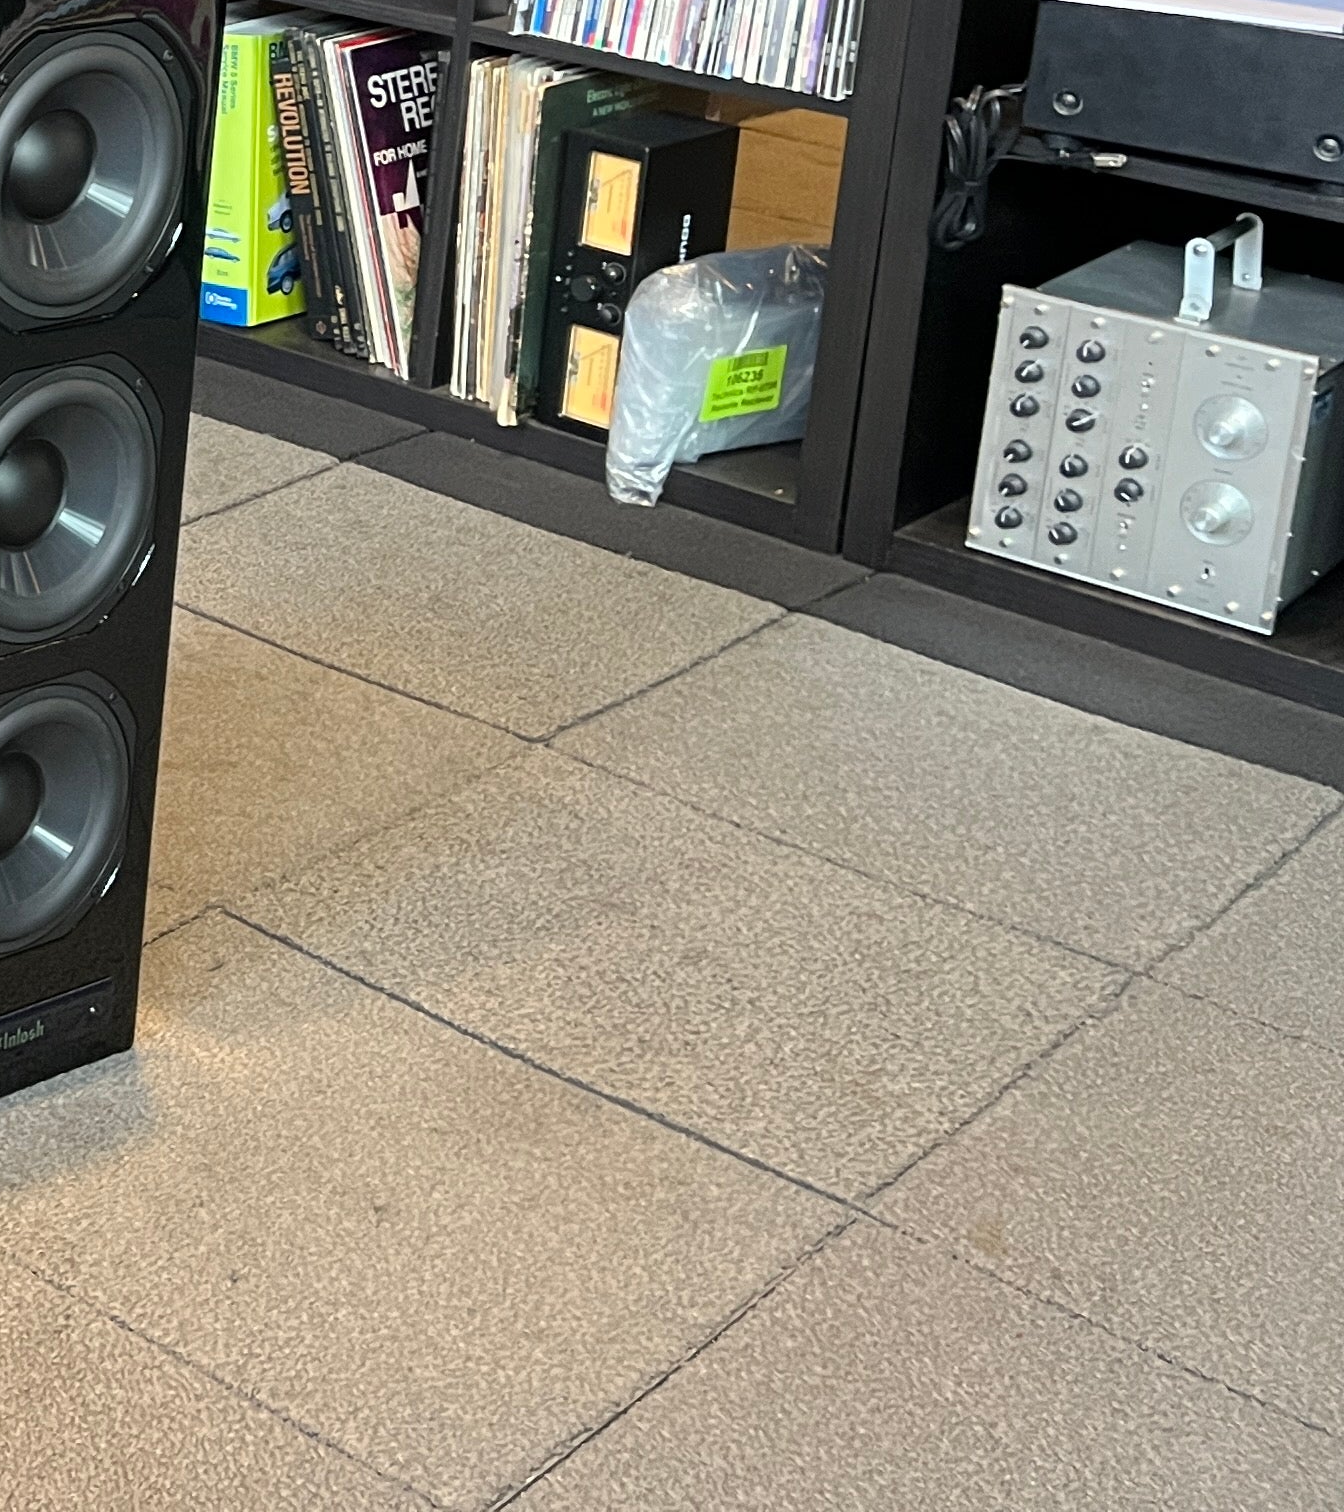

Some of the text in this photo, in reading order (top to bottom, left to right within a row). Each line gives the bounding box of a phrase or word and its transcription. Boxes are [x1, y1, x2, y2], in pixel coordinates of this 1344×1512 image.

[367, 61, 438, 108] STERE
[274, 72, 311, 196] REVOLUTION
[373, 139, 428, 167] FOR HOME
